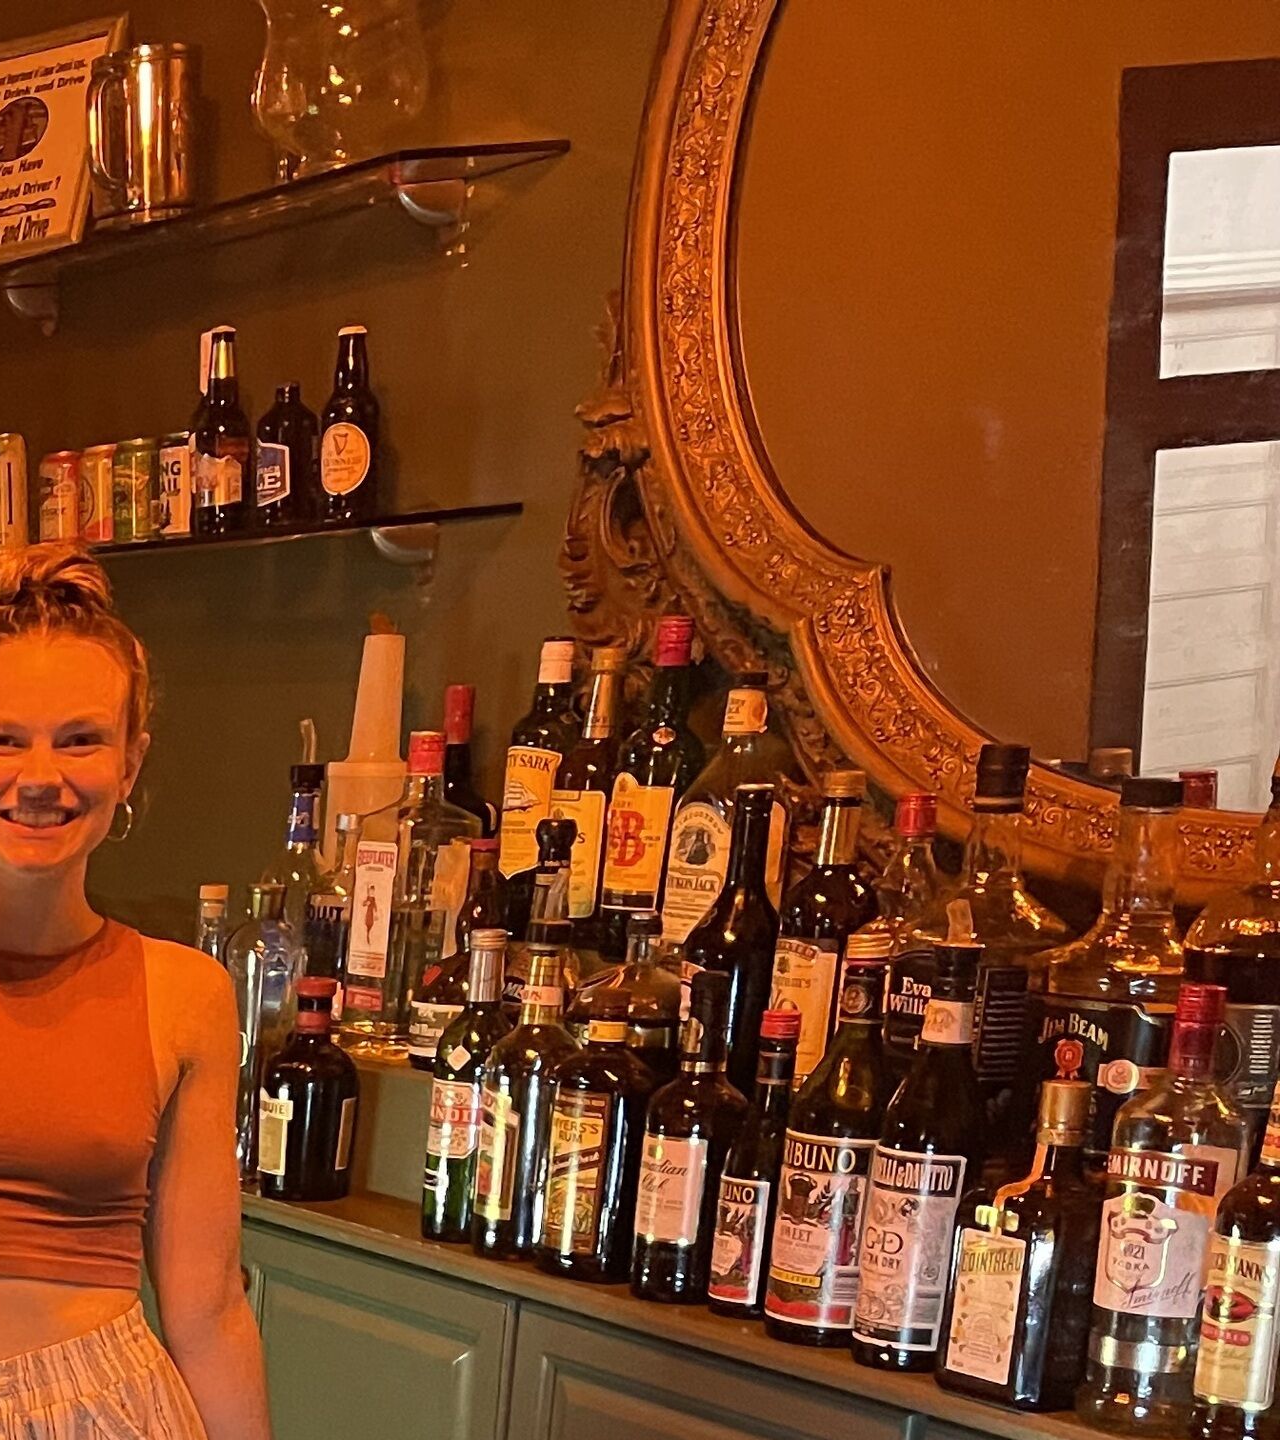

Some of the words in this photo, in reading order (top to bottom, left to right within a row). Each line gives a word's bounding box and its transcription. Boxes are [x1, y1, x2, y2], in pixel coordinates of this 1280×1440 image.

[57, 75, 86, 88] Drive
[18, 159, 44, 173] Have
[22, 180, 54, 196] Driver
[1, 217, 24, 243] and
[23, 215, 50, 241] Drive
[520, 753, 553, 772] SARK
[358, 850, 395, 869] BEEFEATER
[696, 878, 716, 892] JACK
[901, 976, 932, 998] Eva
[1037, 1015, 1065, 1044] JIM
[1068, 1012, 1109, 1051] BEAM
[558, 1131, 584, 1144] RUM
[1107, 1154, 1206, 1187] SMIRNOFF
[881, 1256, 902, 1271] DRY
[960, 1251, 1021, 1273] COINTREAU
[1112, 1256, 1150, 1271] VODKA
